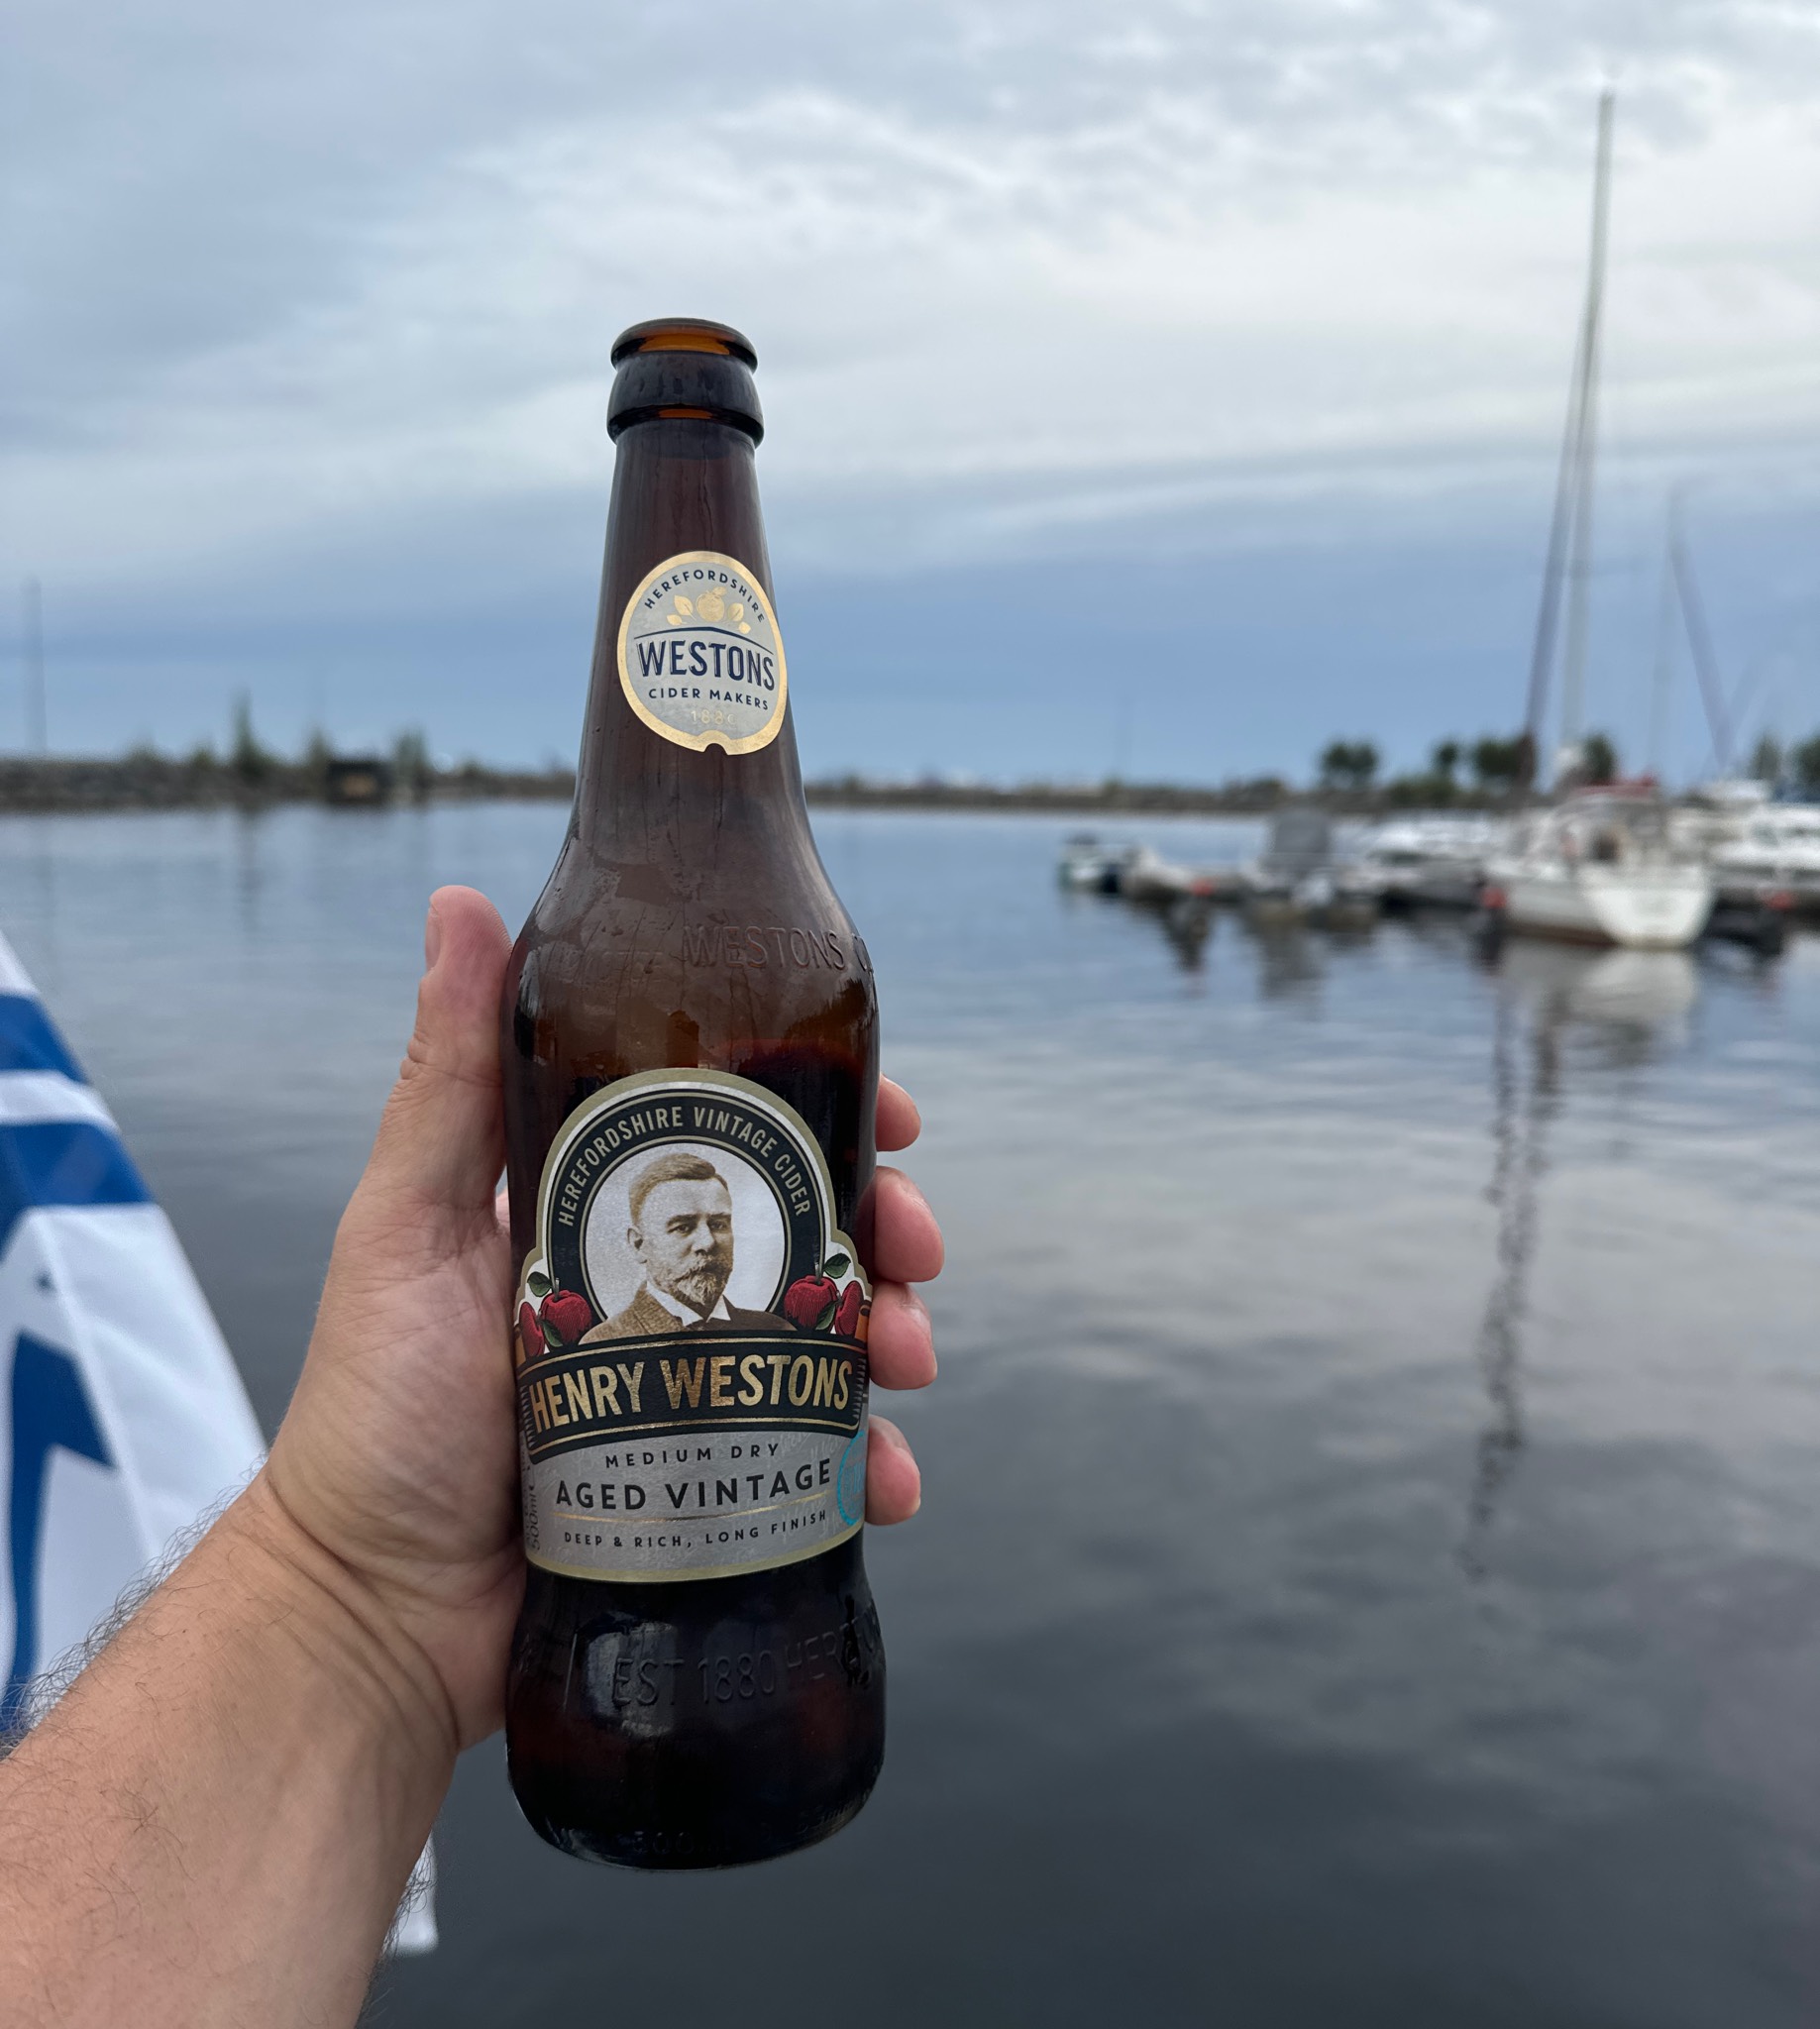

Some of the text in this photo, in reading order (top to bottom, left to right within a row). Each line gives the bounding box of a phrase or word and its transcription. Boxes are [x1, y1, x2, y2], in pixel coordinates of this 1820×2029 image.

[645, 570, 764, 622] HEREFORDSHIRE
[637, 640, 775, 691] WESTONS
[649, 688, 769, 710] CIDER MAKERS
[683, 925, 846, 972] WESTONS
[558, 1106, 811, 1227] HEREFORDSHIRE VINTAGE CIDER
[528, 1353, 853, 1434] HENRY WESTONS
[605, 1442, 780, 1468] MEDIUM DRY
[556, 1480, 647, 1511] AGED
[665, 1458, 831, 1510] VINTAGE
[564, 1510, 826, 1548] DEEP & RICH, LONG FINISH
[611, 1657, 685, 1707] EST
[697, 1649, 776, 1703] 1880
